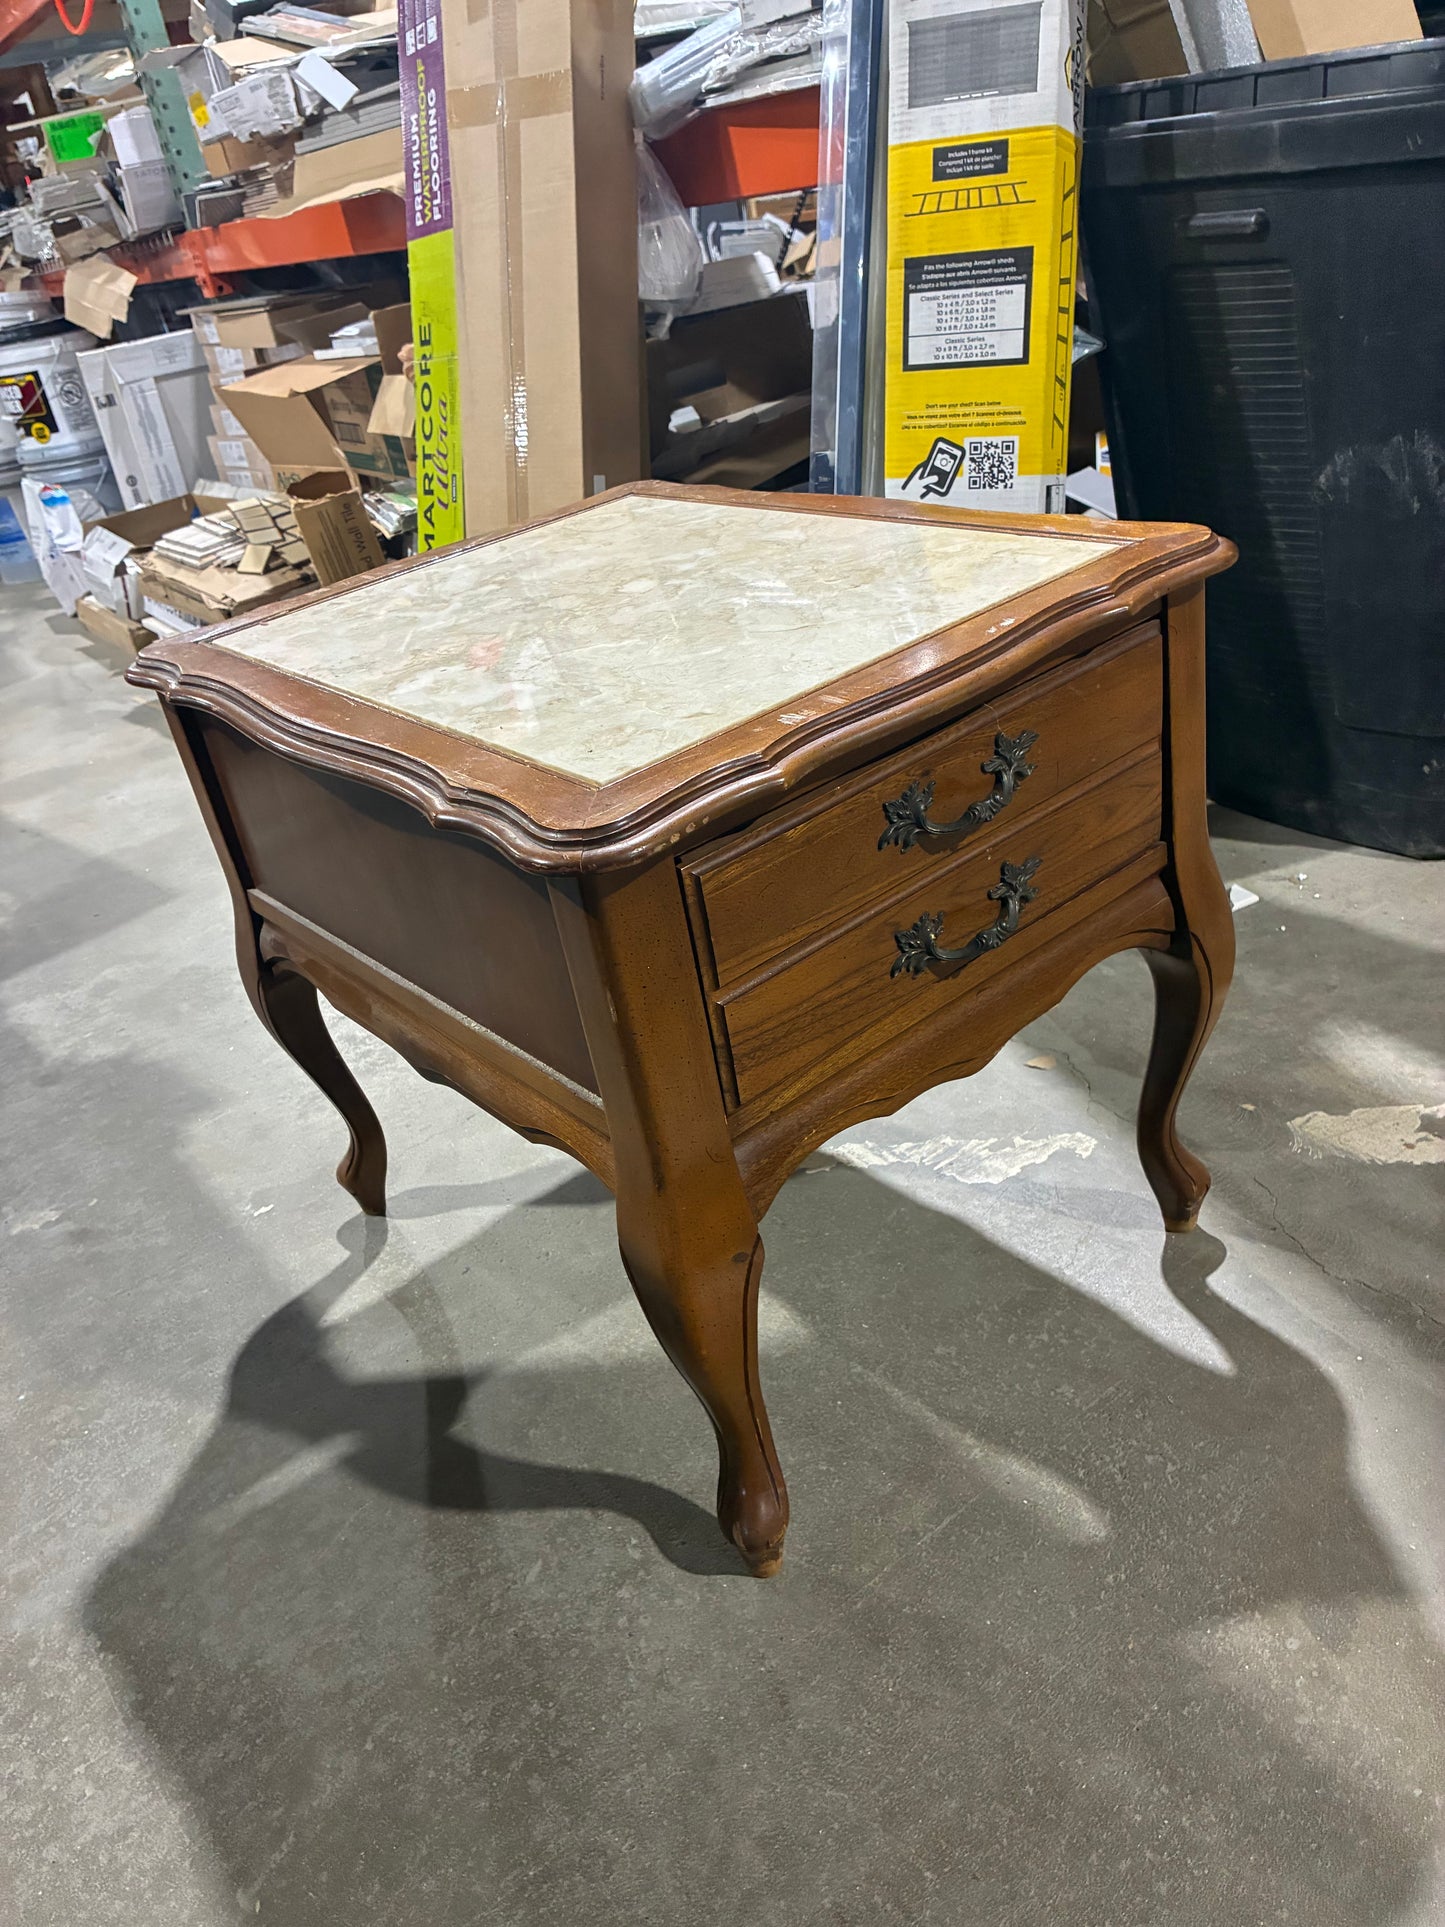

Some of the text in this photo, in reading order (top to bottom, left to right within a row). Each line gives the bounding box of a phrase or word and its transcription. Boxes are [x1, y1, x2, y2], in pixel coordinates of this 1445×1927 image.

[1073, 16, 1083, 130] ARROW
[410, 113, 423, 227] PREMIUM
[416, 59, 431, 224] WATERPROOF
[427, 88, 442, 221] FLOORING
[995, 288, 1014, 296] Series
[945, 335, 985, 345] Classic Series
[341, 503, 356, 523] Tile
[348, 526, 366, 553] Wall
